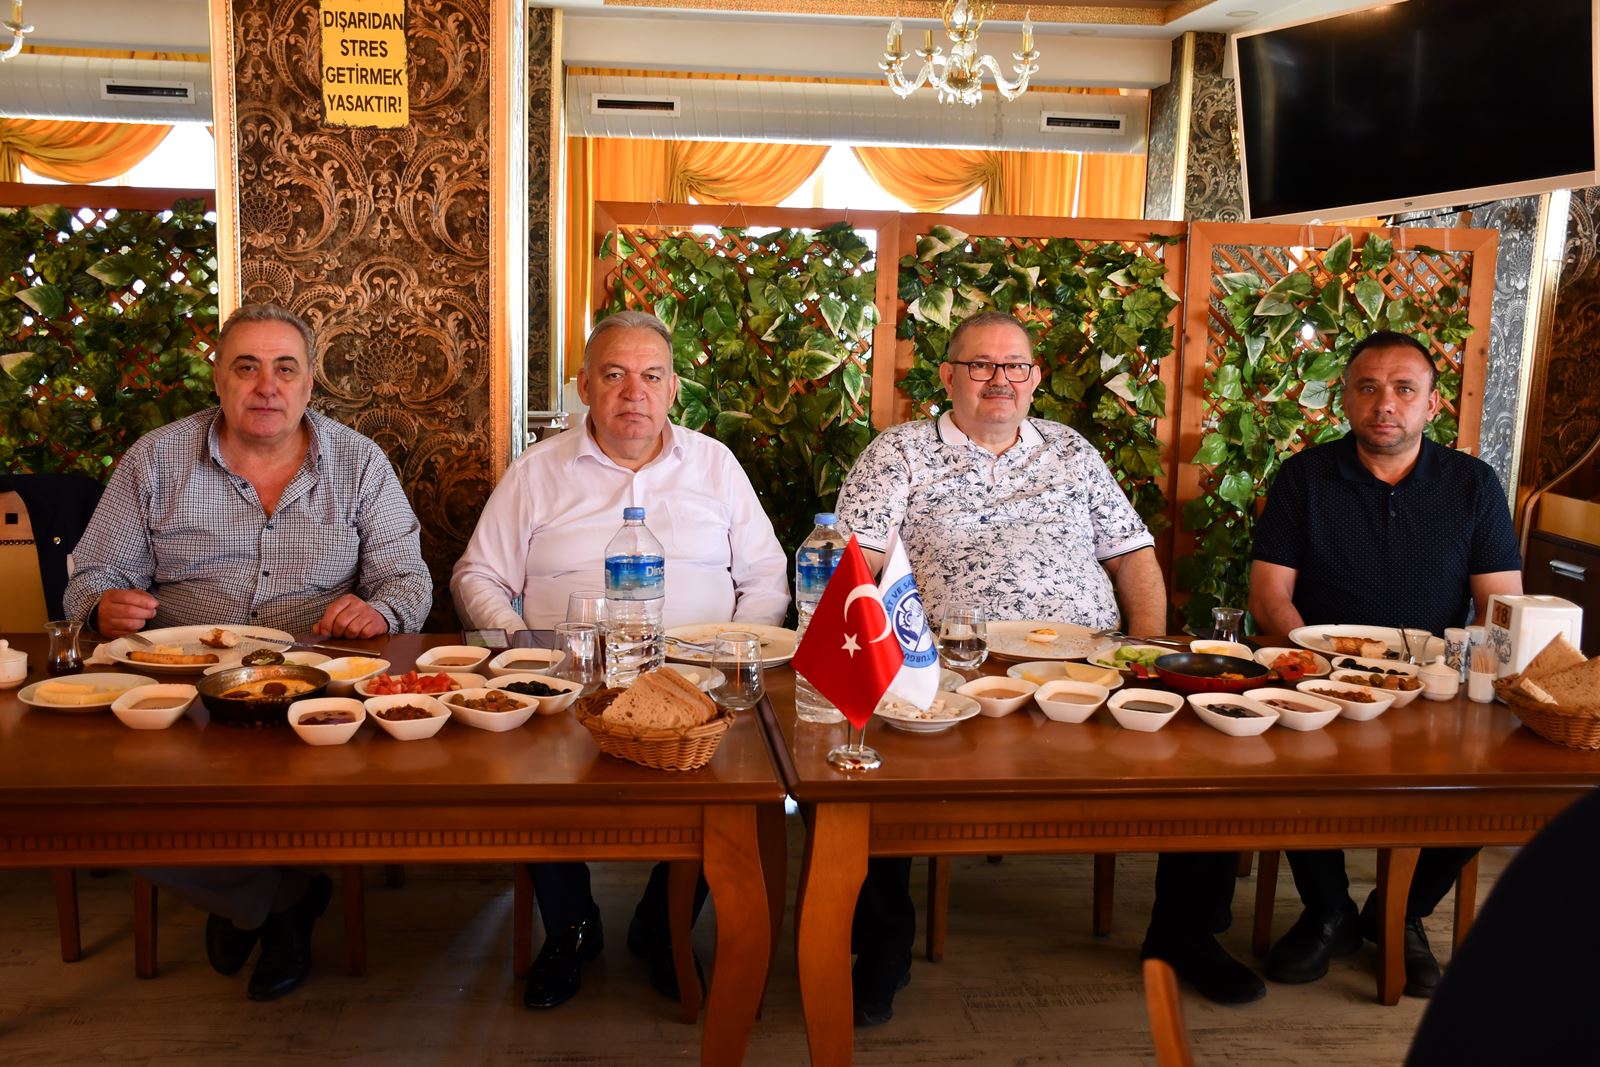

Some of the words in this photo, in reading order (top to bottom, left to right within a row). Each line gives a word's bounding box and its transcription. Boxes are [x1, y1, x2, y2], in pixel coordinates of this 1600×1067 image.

[323, 11, 403, 33] DIŞARIDAN
[340, 39, 388, 58] STRES
[325, 63, 403, 86] GETİRMEK
[327, 94, 402, 113] YASAKTIR!
[1495, 602, 1509, 625] 18
